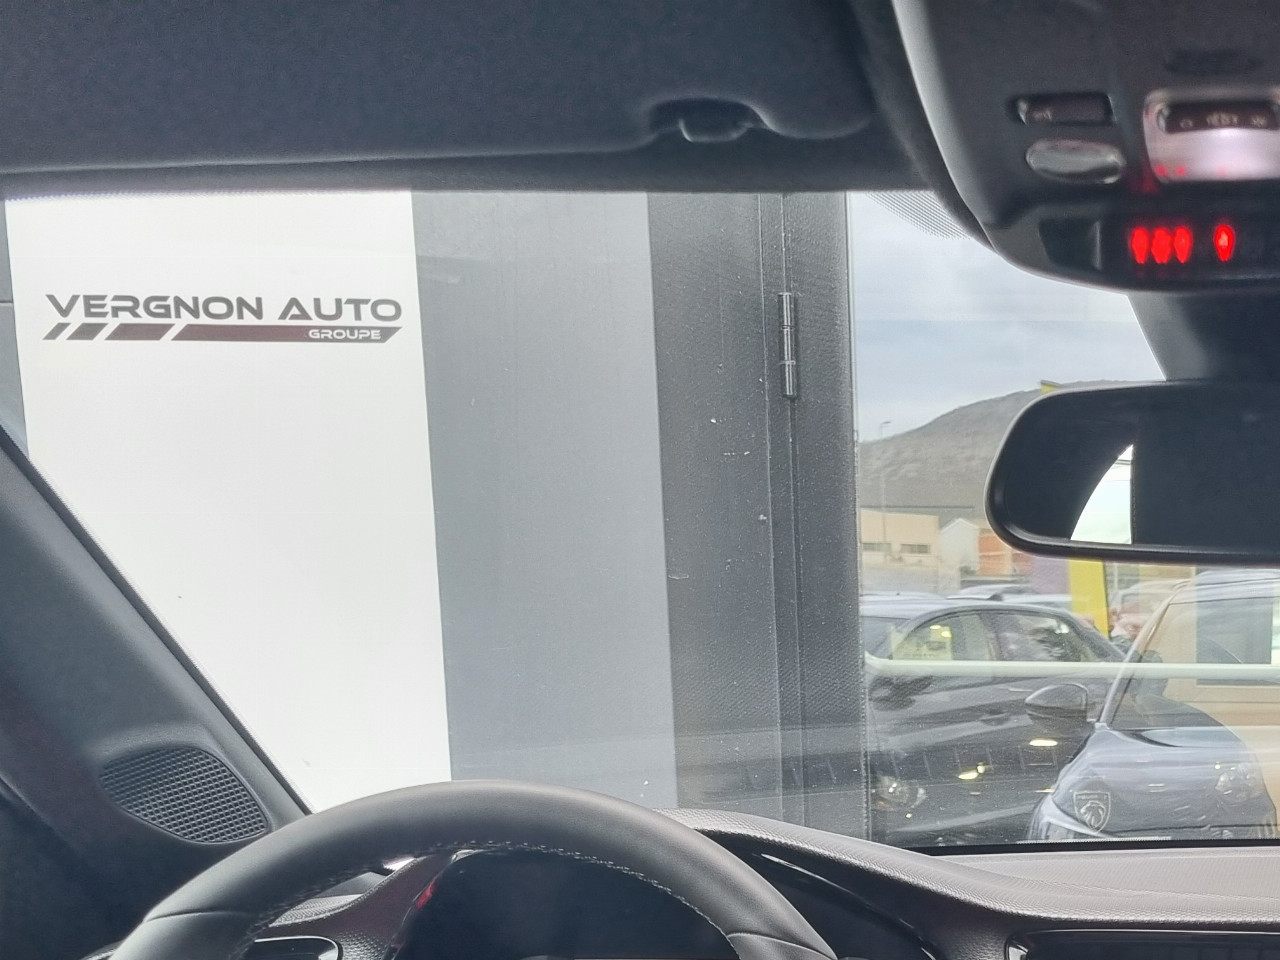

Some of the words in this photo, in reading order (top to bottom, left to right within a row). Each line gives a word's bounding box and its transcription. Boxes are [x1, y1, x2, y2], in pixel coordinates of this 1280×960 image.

[44, 294, 263, 319] VERGNON
[277, 297, 402, 322] AUTO
[308, 328, 382, 341] GROUPE
